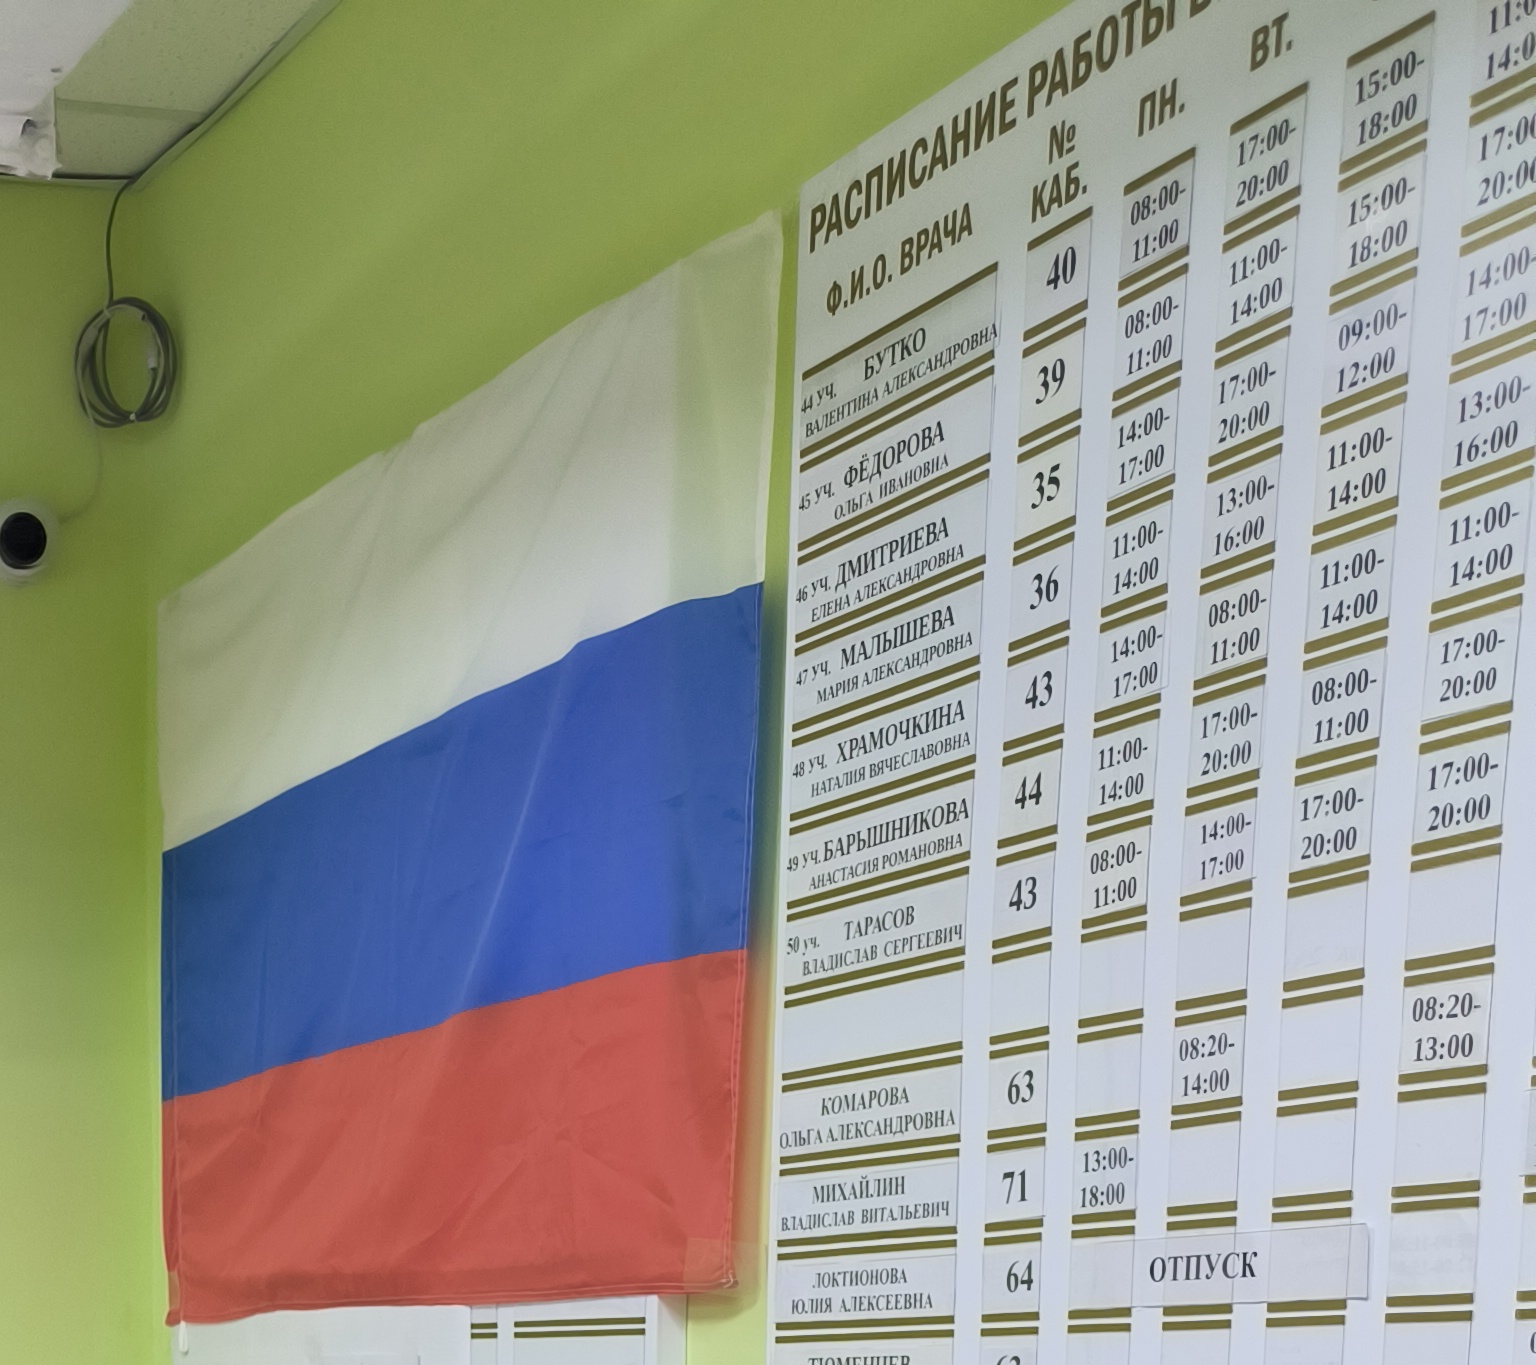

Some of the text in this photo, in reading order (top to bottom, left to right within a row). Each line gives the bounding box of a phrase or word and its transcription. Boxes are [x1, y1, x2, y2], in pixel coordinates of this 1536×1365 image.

[1250, 12, 1293, 72] ВТ.
[1355, 50, 1425, 106] 15:00-
[809, 0, 1176, 254] РАСПИСАНИЕ РАБОТЫ
[1138, 77, 1185, 138] ПН.
[1356, 93, 1418, 147] 18:00
[1048, 120, 1077, 165] №
[1237, 118, 1297, 167] 17:00-
[1031, 161, 1088, 223] КАБ.
[1130, 180, 1186, 226] 08:00-
[1236, 160, 1289, 207] 20:00
[1347, 177, 1416, 228] 15:00-
[826, 203, 973, 316] Ф.И.О. ВРАЧА
[1132, 219, 1179, 263] 11:00
[1348, 220, 1408, 269] 18:00
[1047, 247, 1077, 290] 40
[1229, 238, 1288, 287] 11:00-
[1123, 297, 1180, 339] 08:00-
[1230, 277, 1283, 325] 14:00
[1464, 292, 1527, 342] 17:00
[1338, 312, 1408, 352] 09:00-
[800, 327, 926, 414] 44 УЧ. БУТКО
[1126, 335, 1173, 377] 11:00
[1337, 346, 1396, 393] 12:00
[804, 323, 998, 438] ВАЛЕНТИНА АЛЕКСАНДРОВНА
[1036, 358, 1065, 404] 39
[1217, 361, 1276, 406] 17:00-
[1456, 376, 1531, 425] 13:00-
[1117, 407, 1170, 449] 14:00-
[1217, 401, 1270, 444] 20:00
[1118, 444, 1164, 486] 17:00
[1326, 427, 1393, 471] 11:00-
[1454, 420, 1518, 468] 16:00
[799, 421, 945, 511] 45 УЧ. ФЁДОРОВА
[834, 452, 949, 521] ОЛЬГА ИВАНОВНА
[1031, 463, 1061, 509] 35
[1216, 475, 1275, 518] 13:00-
[1327, 468, 1386, 512] 14:00
[1112, 520, 1164, 559] 11:00-
[1214, 516, 1265, 557] 16:00
[1449, 501, 1520, 546] 11:00-
[795, 516, 949, 603] 46 УЧ. ДМИТРИЕВА
[1112, 556, 1159, 595] 14:00
[1320, 548, 1385, 589] 11:00-
[1449, 543, 1513, 588] 14:00
[811, 543, 964, 623] ЕЛЕНА АЛЕКСАНДРОВНА
[1030, 565, 1059, 610] 36
[1208, 589, 1267, 627] 08:00-
[1320, 589, 1379, 630] 14:00
[795, 605, 955, 687] 47 УЧ. МАЛЫШЕВА
[1110, 625, 1163, 664] 14:00-
[1210, 628, 1260, 665] 11:00
[1440, 629, 1506, 665] 17:00-
[816, 632, 973, 705] МАРИЯ АЛЕКСАНДРОВНА
[1113, 661, 1158, 699] 17:00
[1311, 669, 1378, 705] 08:00-
[1439, 667, 1497, 702] 20:00
[1025, 670, 1053, 710] 43
[792, 700, 966, 778] 48 УЧ. ХРАМОЧКИНА
[1200, 703, 1258, 739] 17:00-
[1313, 709, 1369, 744] 11:00
[811, 732, 970, 798] НАТАЛИЯ ВЯЧЕСЛАВОВНА
[1098, 737, 1148, 771] 11:00-
[1200, 740, 1252, 776] 20:00
[1427, 752, 1499, 792] 17:00-
[1015, 772, 1042, 809] 44
[1099, 773, 1144, 807] 14:00
[1300, 787, 1364, 822] 17:00-
[1200, 812, 1252, 844] 14:00-
[1427, 794, 1491, 832] 20:00
[786, 798, 969, 872] 49 УЧ. БАРЫШНИКОВА
[1301, 827, 1357, 860] 20:00
[808, 833, 963, 891] АНАСТАСИЯ РОМАНОВНА
[1090, 841, 1143, 875] 08:00-
[1199, 849, 1244, 880] 17:00
[1009, 876, 1038, 912] 43
[1093, 876, 1137, 909] 11:00
[786, 906, 915, 956] 50 уч. ТАРАСОВ
[802, 924, 963, 977] ВЛАДИСЛАВ СЕРГЕЕВИЧ
[1412, 992, 1482, 1022] 08:20-
[1179, 1032, 1235, 1062] 08:20-
[1413, 1033, 1474, 1063] 13:00
[820, 1086, 910, 1116] КОМАРОВА
[1007, 1069, 1034, 1104] 63
[1181, 1068, 1230, 1097] 14:00
[779, 1109, 955, 1150] ОЛЬГА АЛЕКСАНДРОВНА
[1083, 1146, 1134, 1173] 13:00-
[812, 1176, 905, 1204] МИХАЙЛИН
[1002, 1169, 1028, 1204] 71
[1079, 1182, 1125, 1208] 18:00
[781, 1200, 950, 1232] ВЛАДИСЛАВ ВИТАЛЬЕВИЧ
[812, 1268, 908, 1289] ЛОКТИОНОВА
[1006, 1260, 1033, 1293] 64
[1149, 1252, 1258, 1282] ОТПУСК
[791, 1293, 933, 1315] ЮЛИЯ АЛЕКСЕЕВНА
